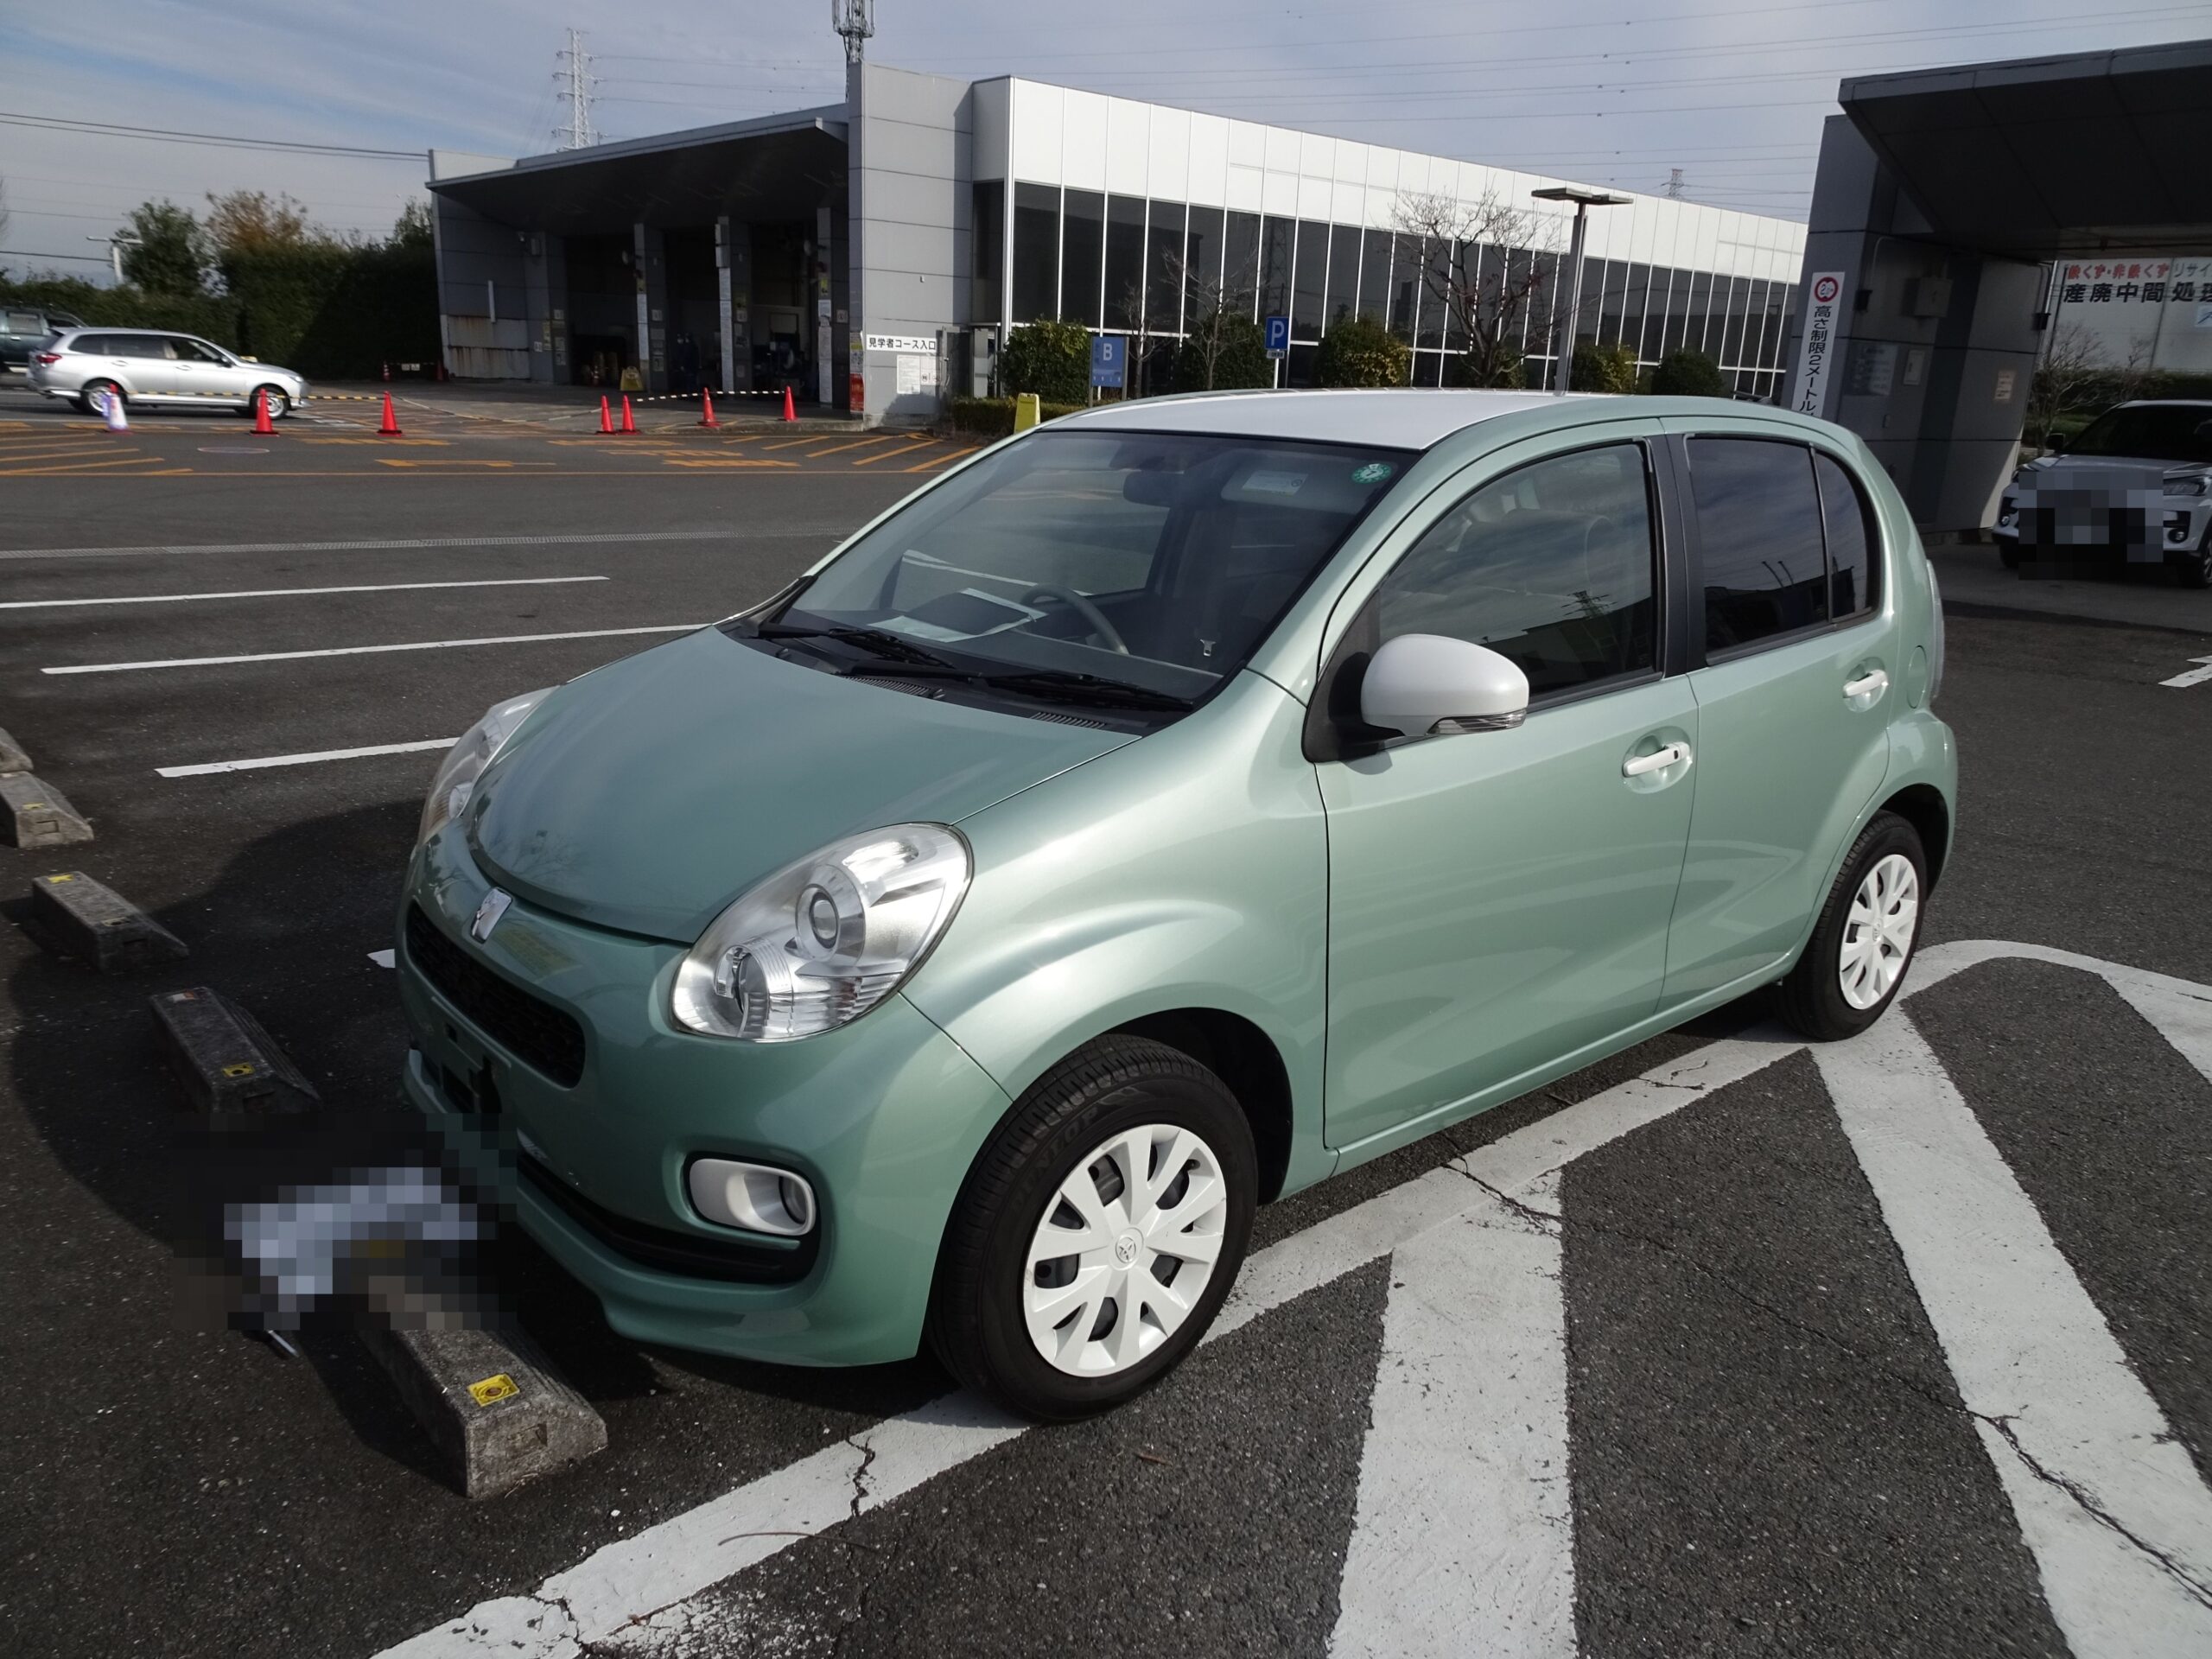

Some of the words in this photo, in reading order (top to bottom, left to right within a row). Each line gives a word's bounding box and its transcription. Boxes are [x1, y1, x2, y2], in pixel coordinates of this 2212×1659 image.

[869, 337, 936, 350] 見学者コース入口
[1271, 321, 1285, 346] P
[1103, 343, 1113, 361] B
[1799, 305, 1832, 416] 高さ制限2メートル
